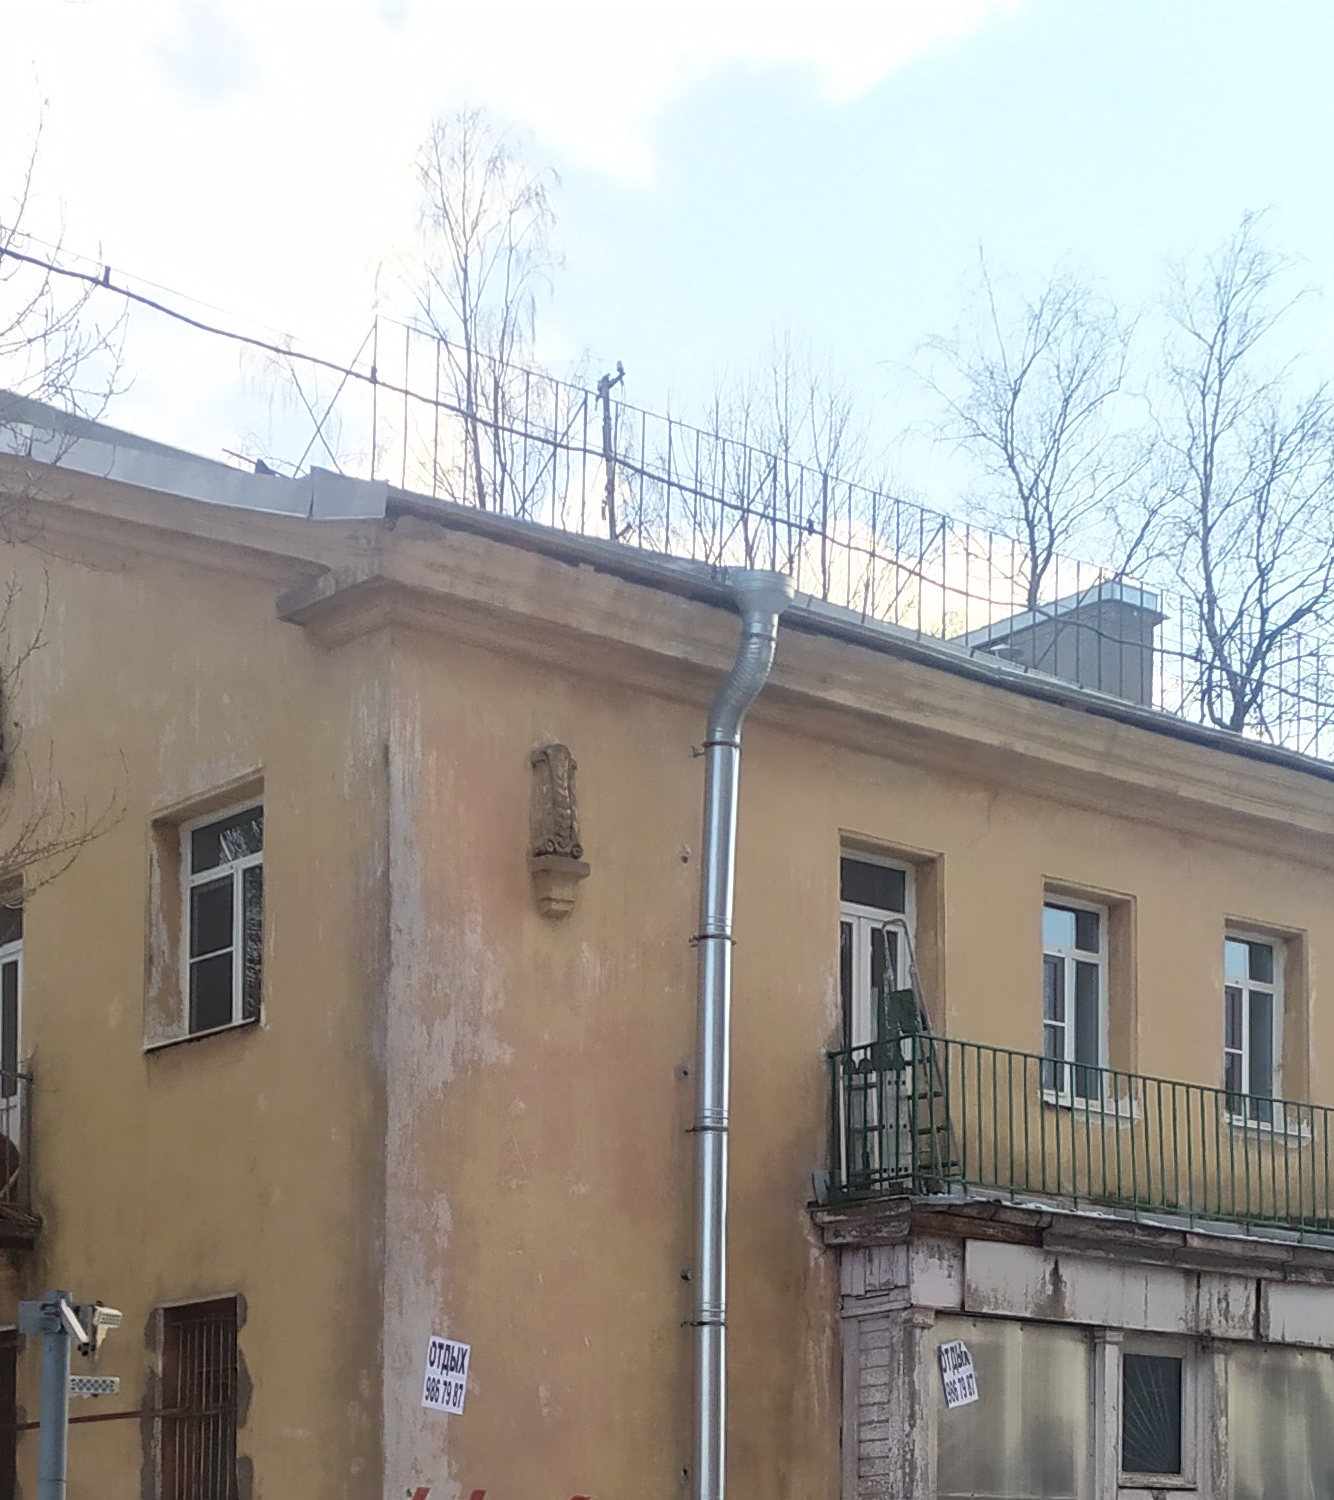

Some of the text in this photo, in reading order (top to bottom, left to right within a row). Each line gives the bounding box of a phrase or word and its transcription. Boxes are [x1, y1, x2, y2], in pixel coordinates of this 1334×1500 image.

[429, 1340, 468, 1376] ОТДЫХ
[425, 1376, 464, 1408] 986 79 87
[958, 1376, 968, 1400] 79
